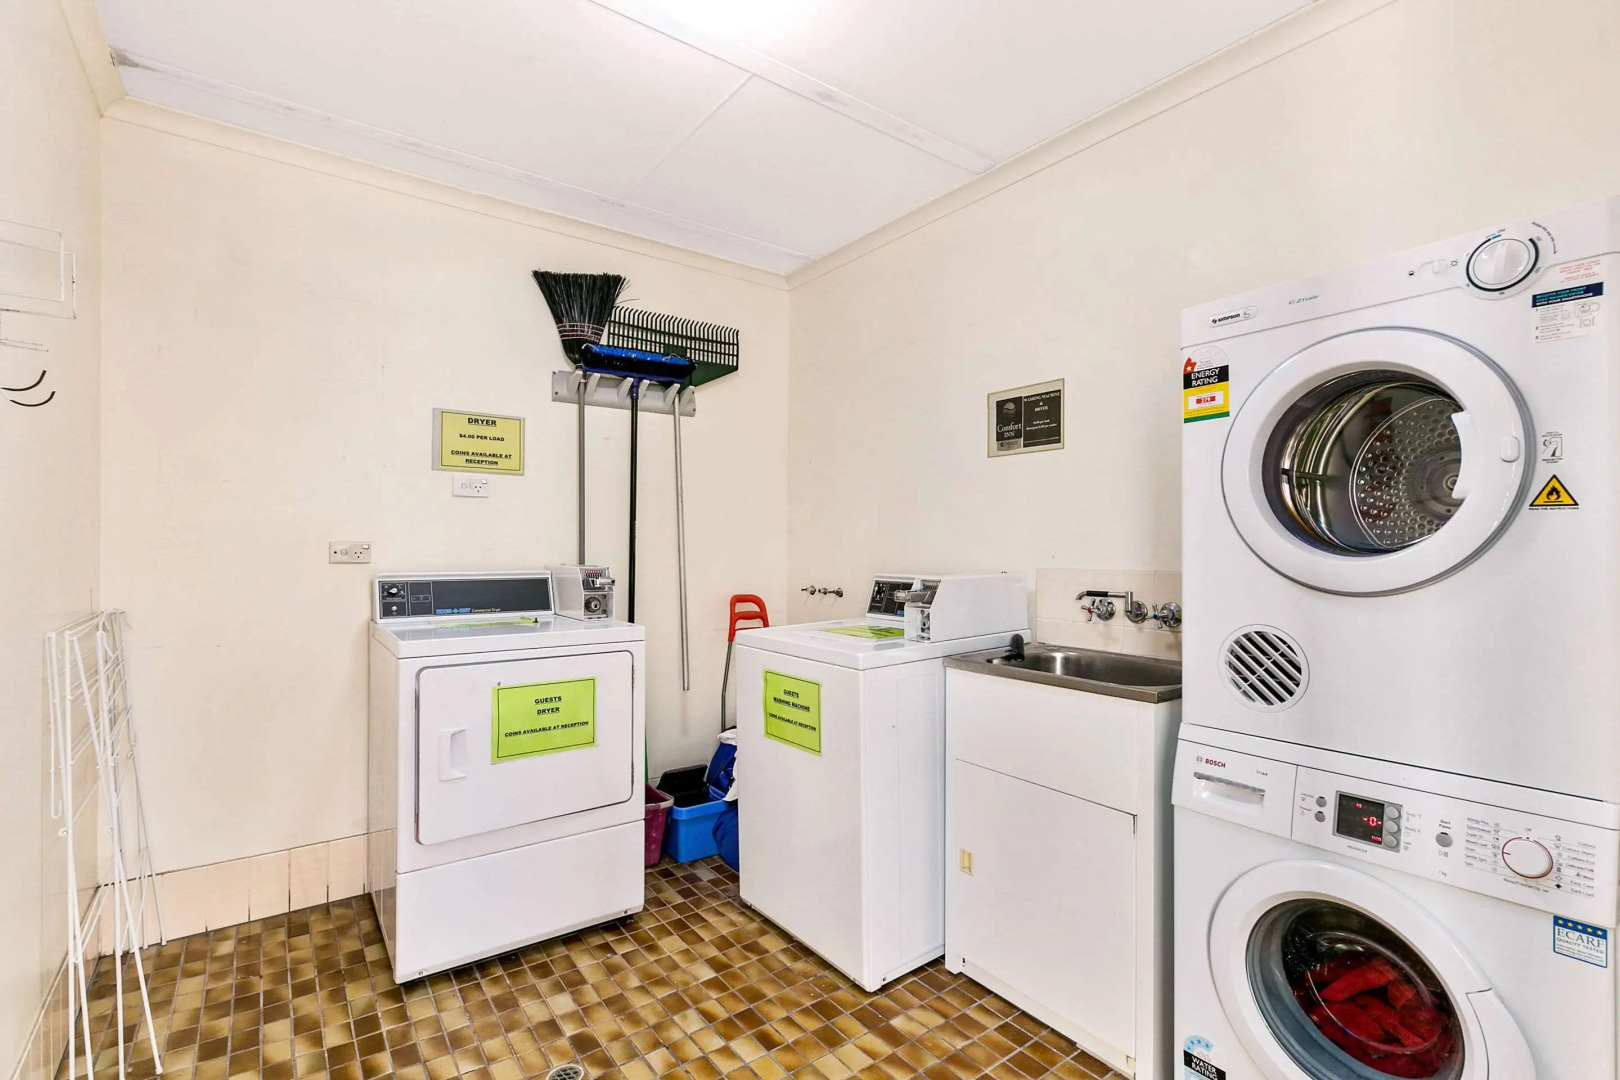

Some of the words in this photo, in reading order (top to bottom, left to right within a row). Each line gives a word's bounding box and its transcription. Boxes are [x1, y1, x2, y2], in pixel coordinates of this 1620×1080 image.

[1191, 368, 1220, 379] ENERGY
[1191, 376, 1218, 387] RATING
[1042, 391, 1061, 399] MACHINE
[467, 417, 497, 427] DRYER
[997, 422, 1022, 433] Comfort
[471, 451, 503, 459] AVAILABLE
[465, 458, 499, 466] RECEPTION
[783, 689, 799, 698] GUESTS
[534, 696, 562, 705] GUESTS
[773, 696, 791, 707] WASHING
[791, 701, 811, 712] MACHINE
[536, 707, 560, 716] DRYER
[504, 730, 522, 738] COINS
[522, 726, 552, 735] AVAILABLE
[560, 721, 589, 729] RECEPTION
[1205, 758, 1226, 768] BOSCH
[1556, 937, 1581, 947] QUALITY
[1557, 928, 1605, 948] ECARF
[1191, 1056, 1217, 1074] WATER
[1191, 1061, 1218, 1080] RATING
